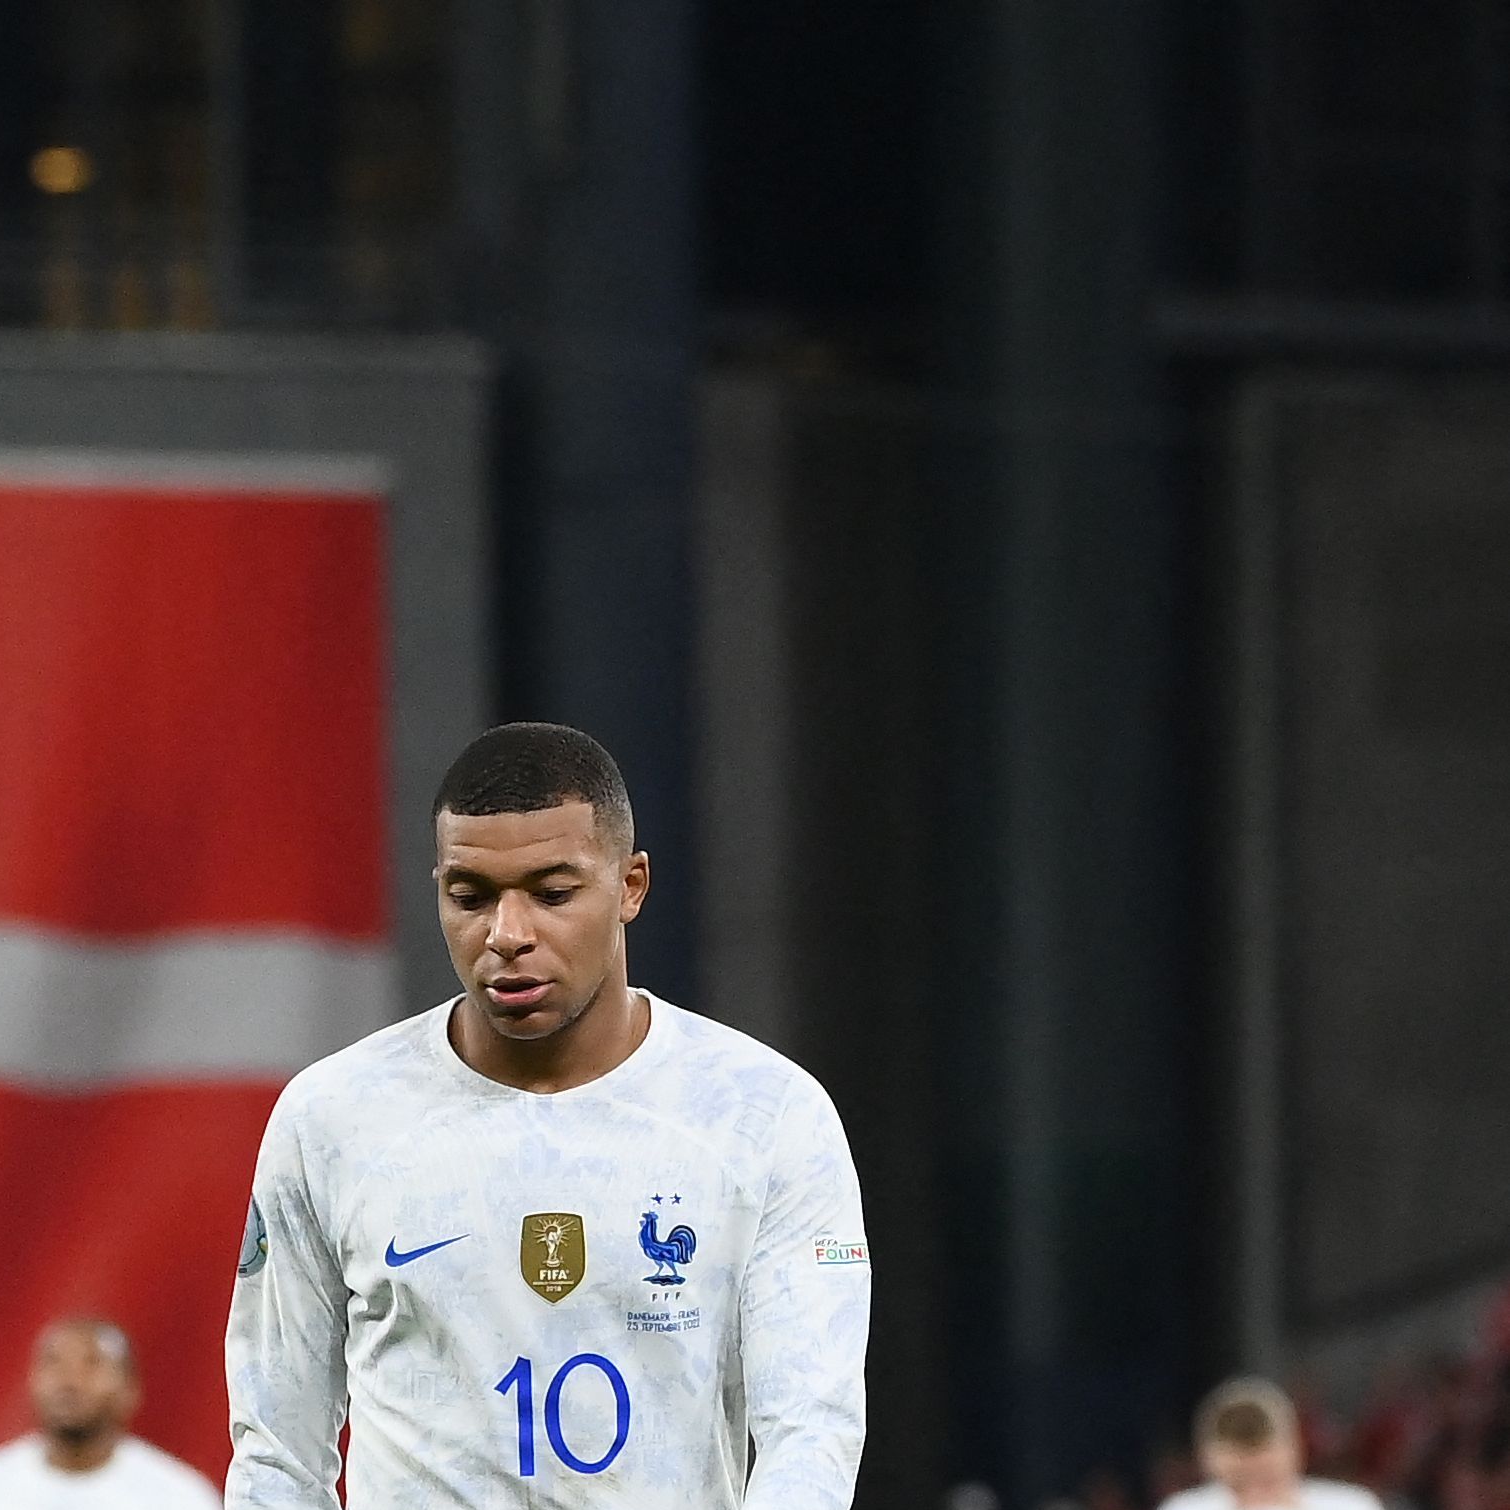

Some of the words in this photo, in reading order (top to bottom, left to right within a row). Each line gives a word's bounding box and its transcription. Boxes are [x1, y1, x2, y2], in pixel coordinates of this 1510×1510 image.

[539, 1269, 568, 1281] FIFA
[627, 1311, 671, 1322] DANEMARK
[626, 1321, 639, 1332] 25
[494, 1353, 630, 1477] 10
